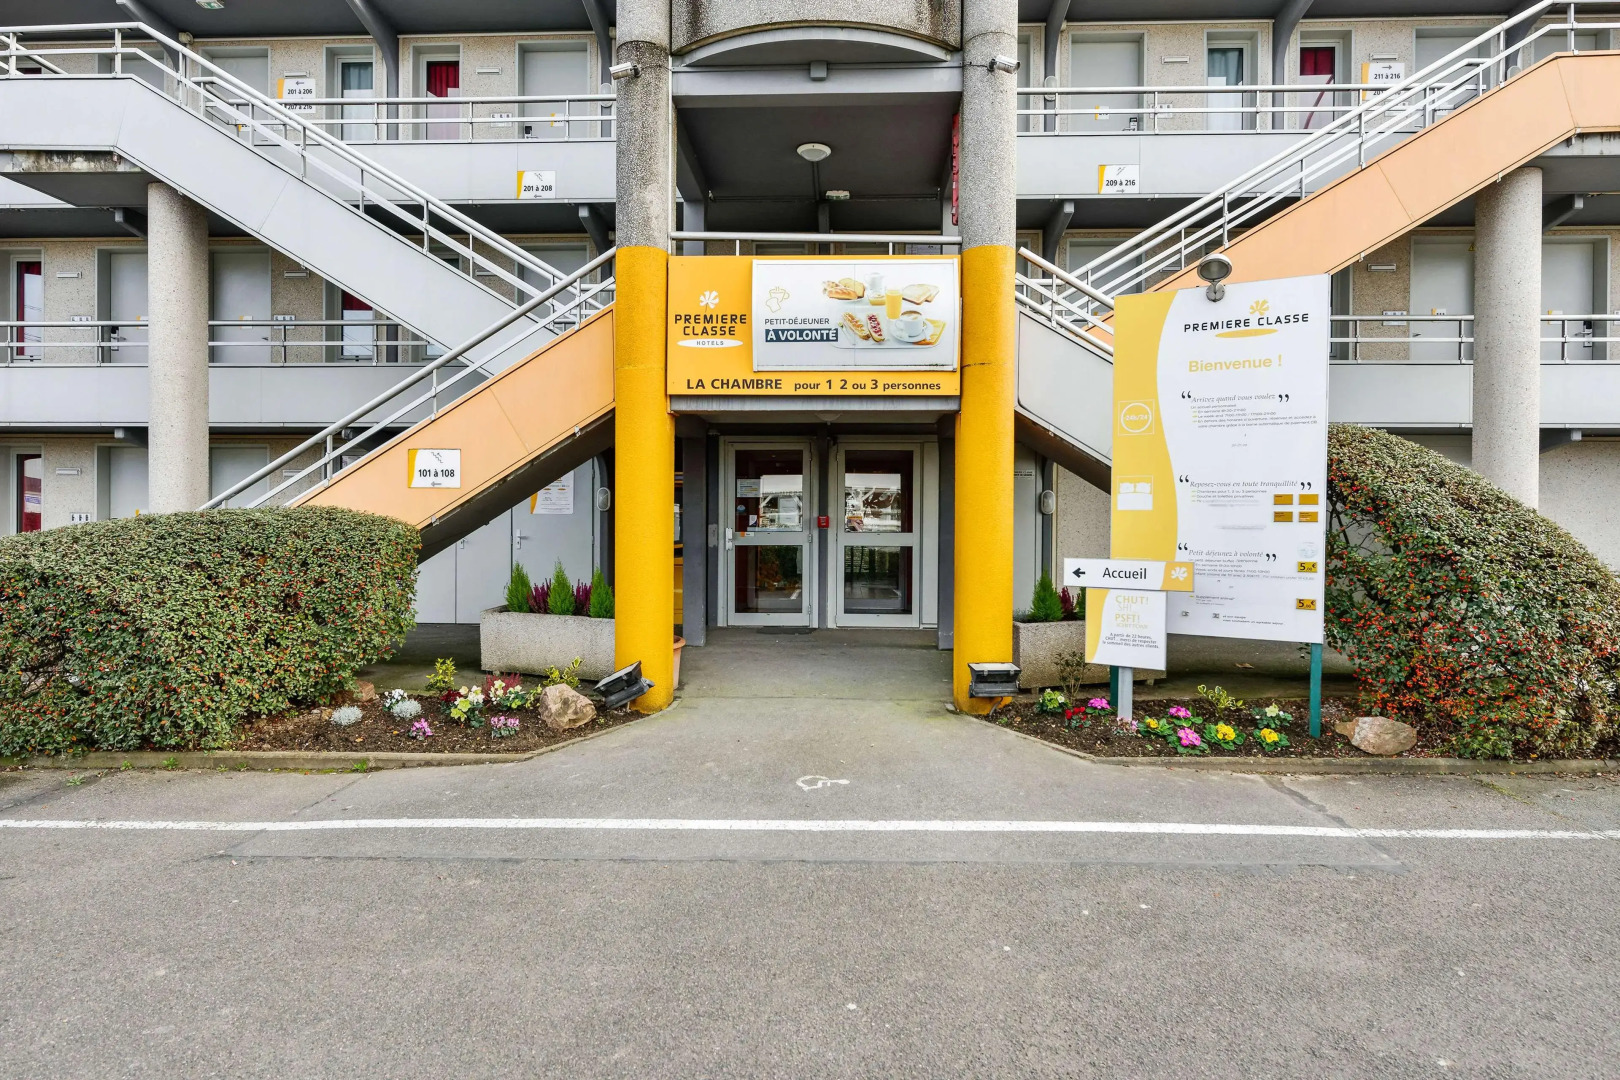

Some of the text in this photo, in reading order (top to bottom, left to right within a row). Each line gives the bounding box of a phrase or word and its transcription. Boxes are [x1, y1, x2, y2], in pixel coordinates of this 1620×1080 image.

[524, 184, 553, 192] 201 à 208
[1105, 178, 1136, 187] 209 à 216
[674, 313, 747, 325] PREMIERE
[764, 316, 830, 326] PETIT-DÉJEUNER
[1183, 313, 1310, 333] PREMIERE CLASSE
[682, 325, 736, 337] CLASSE
[766, 327, 838, 342] À VOLONTÉ
[1188, 356, 1273, 374] Bienvenue
[686, 378, 941, 392] LA CHAMBRE pour 1 2 ou 3 personnes
[418, 468, 455, 478] 101 à 108
[1102, 568, 1147, 579] Accueil
